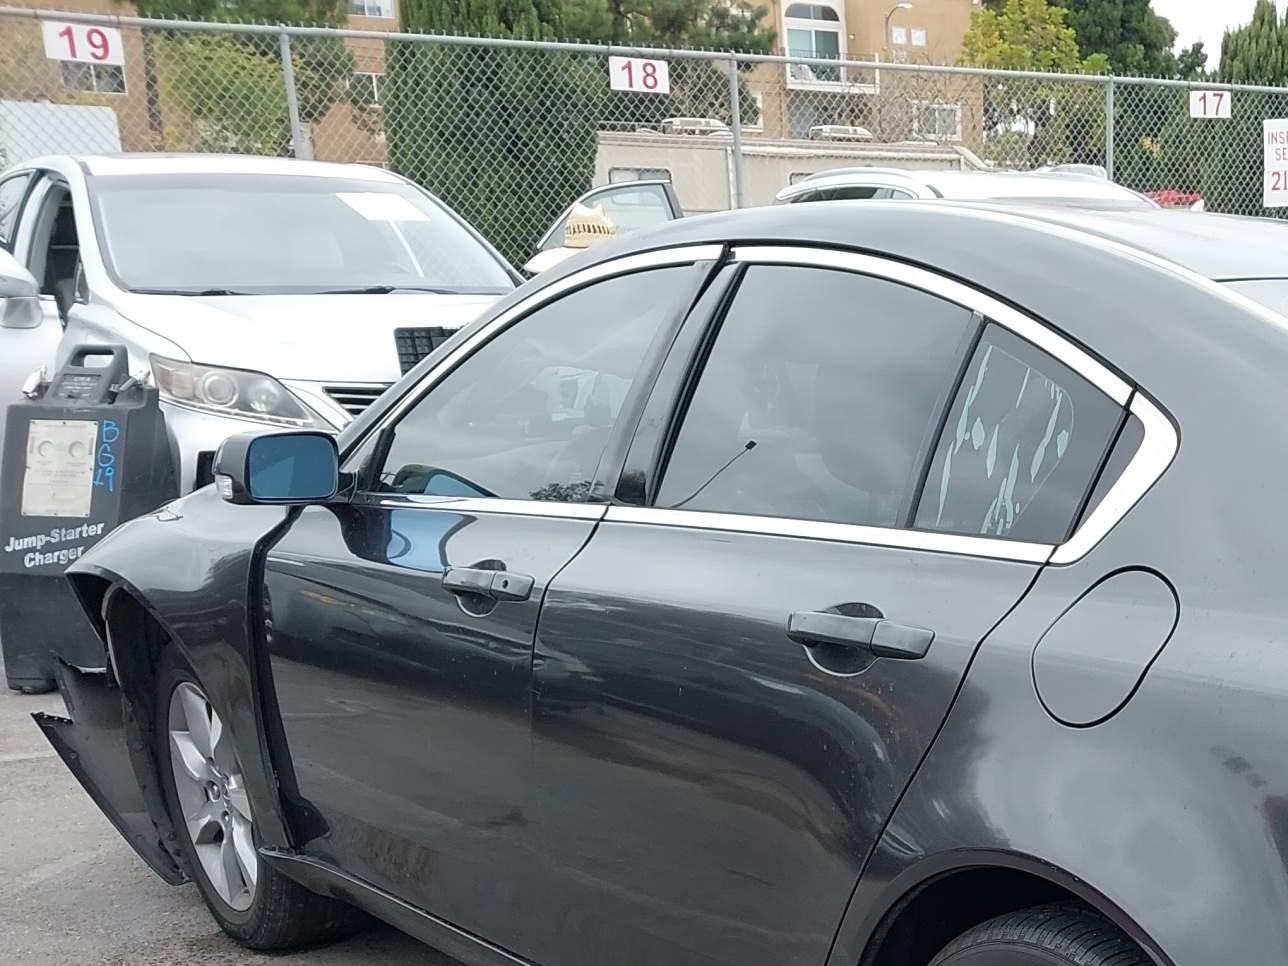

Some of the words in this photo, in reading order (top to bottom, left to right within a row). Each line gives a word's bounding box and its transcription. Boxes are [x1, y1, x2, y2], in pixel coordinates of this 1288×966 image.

[58, 25, 110, 61] 19
[620, 60, 658, 90] 18
[1198, 92, 1225, 117] 17
[5, 522, 105, 553] Jump-Starter
[24, 546, 84, 569] Charger
